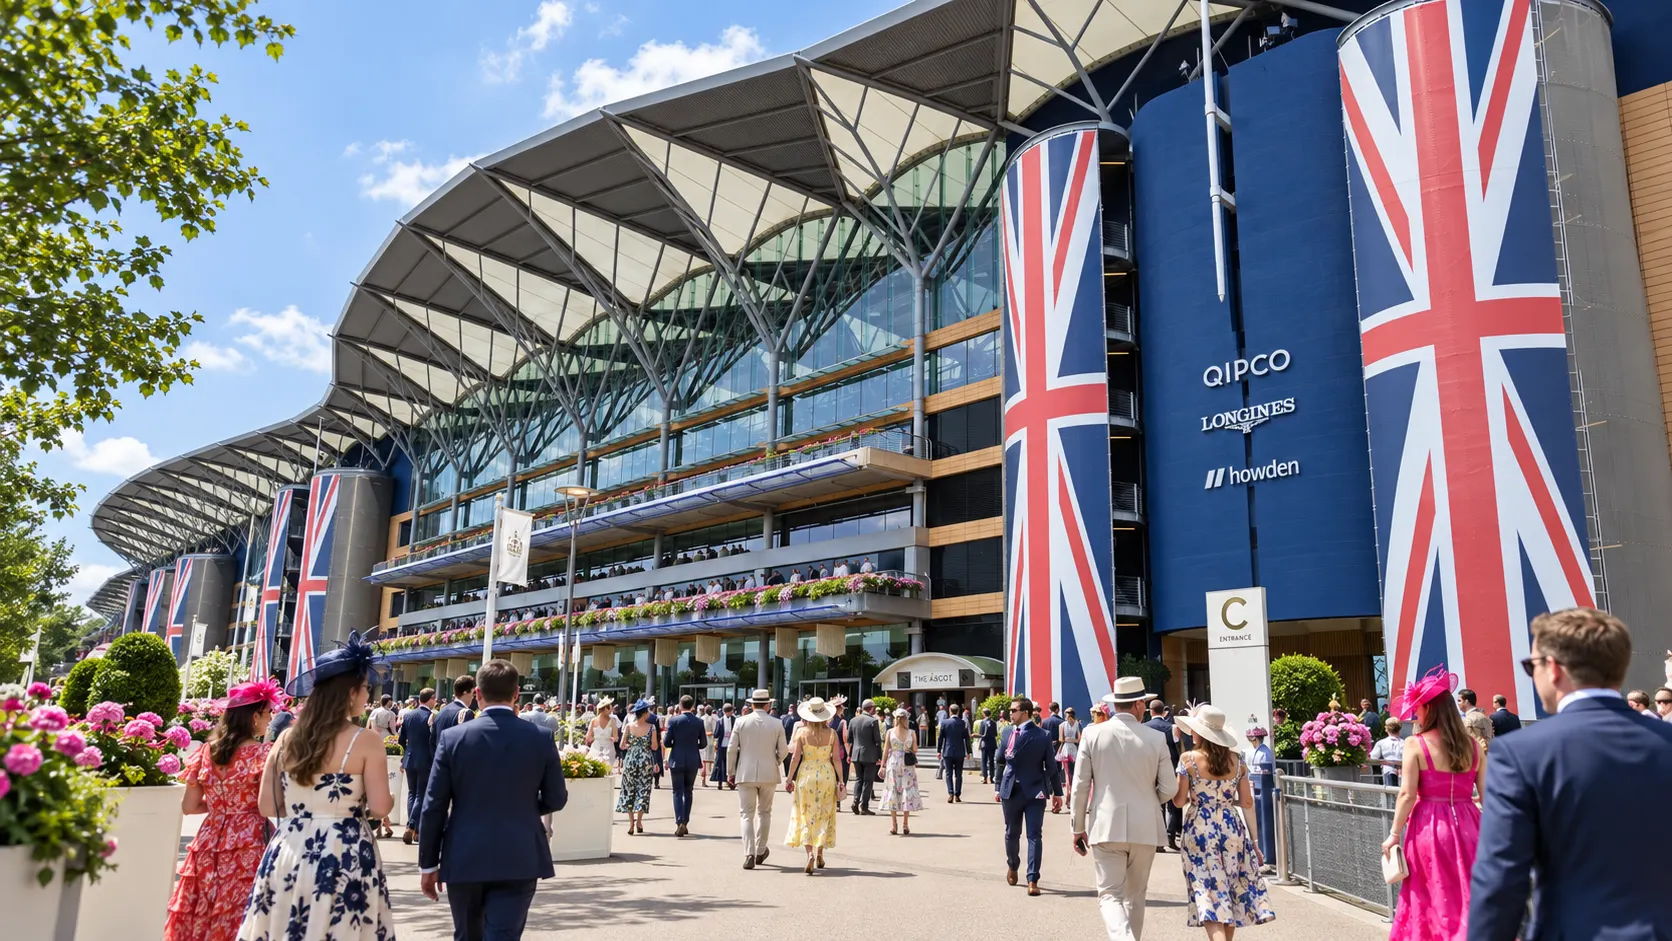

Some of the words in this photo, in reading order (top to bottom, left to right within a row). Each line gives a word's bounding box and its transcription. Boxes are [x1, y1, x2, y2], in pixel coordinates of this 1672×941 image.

[1203, 349, 1291, 388] QIPCO
[1201, 397, 1296, 431] LONGINES
[1230, 459, 1300, 485] howden
[1221, 597, 1248, 631] C
[1219, 634, 1252, 643] ENTRANCE
